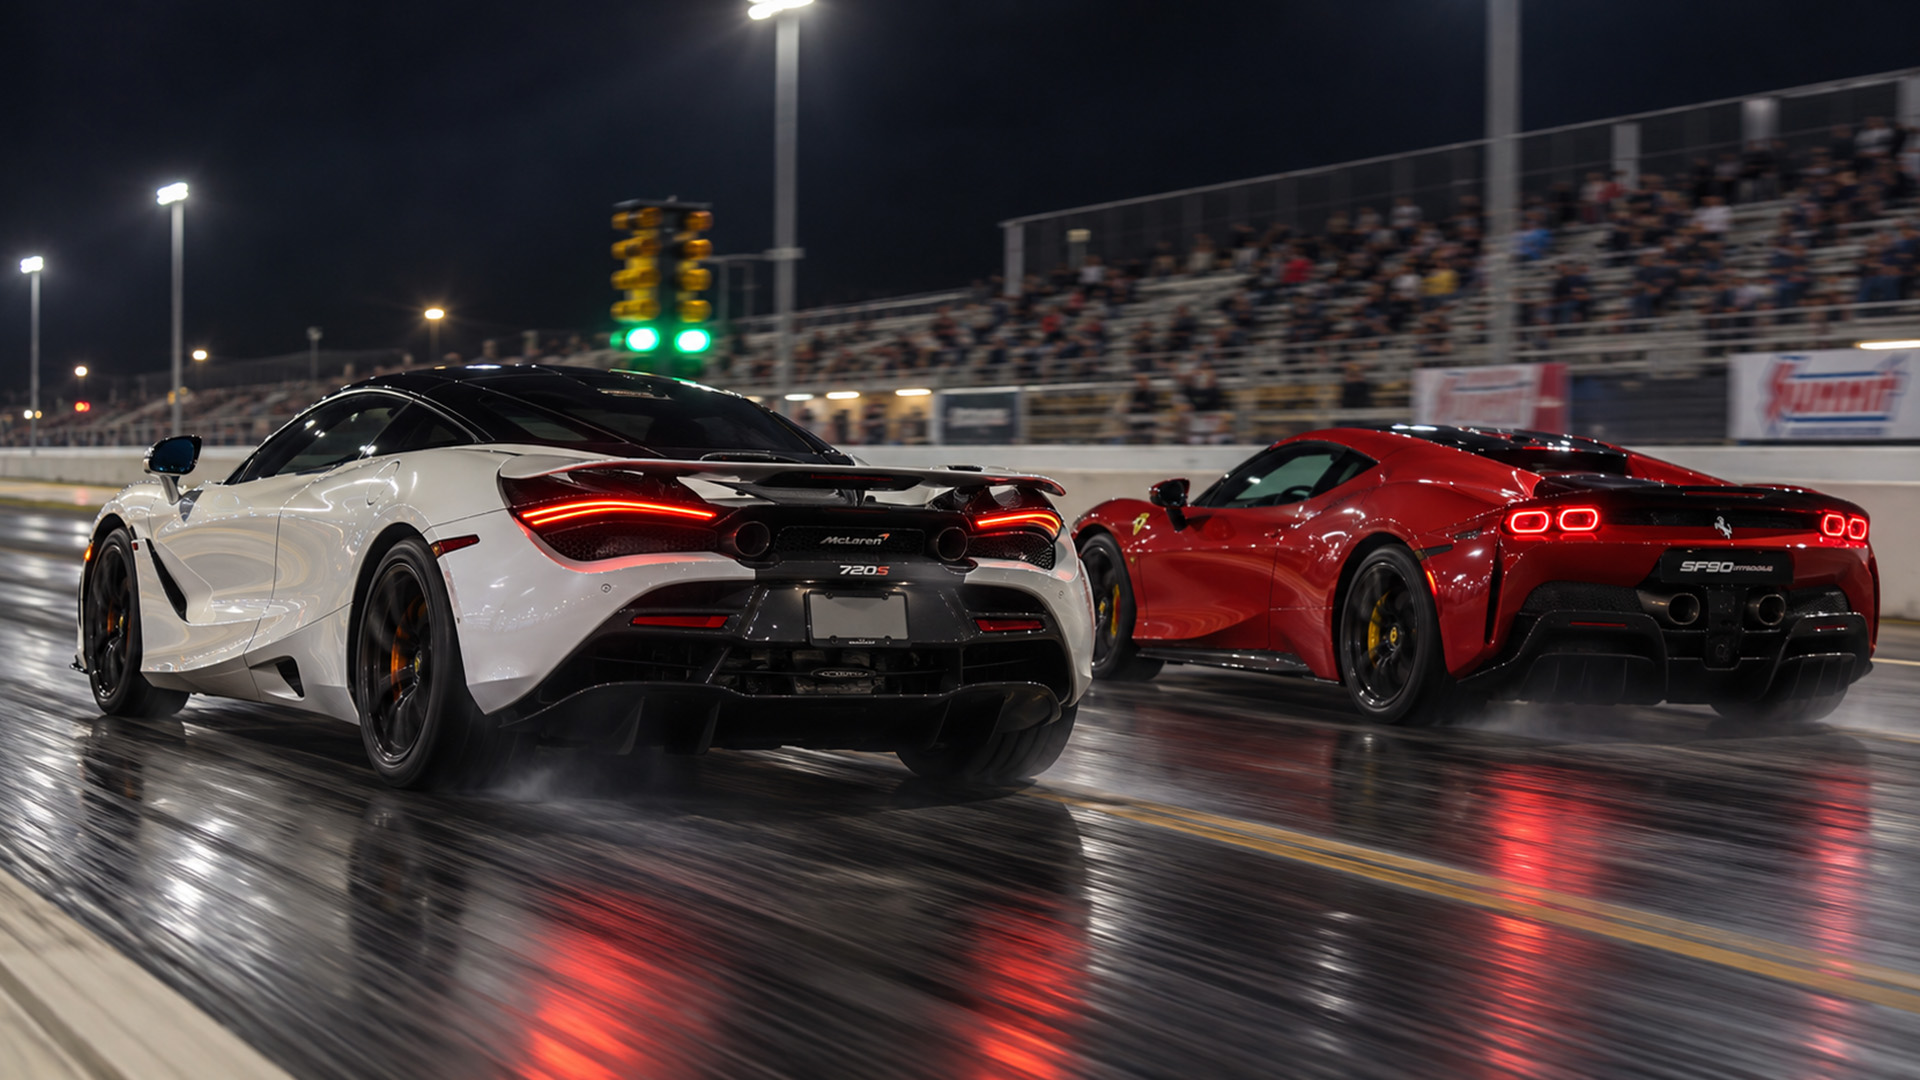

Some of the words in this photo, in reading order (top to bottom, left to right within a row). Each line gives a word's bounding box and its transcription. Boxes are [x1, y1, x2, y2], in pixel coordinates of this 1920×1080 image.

[820, 536, 882, 545] McLaren
[840, 565, 890, 576] 720S
[1680, 561, 1734, 573] SF90
